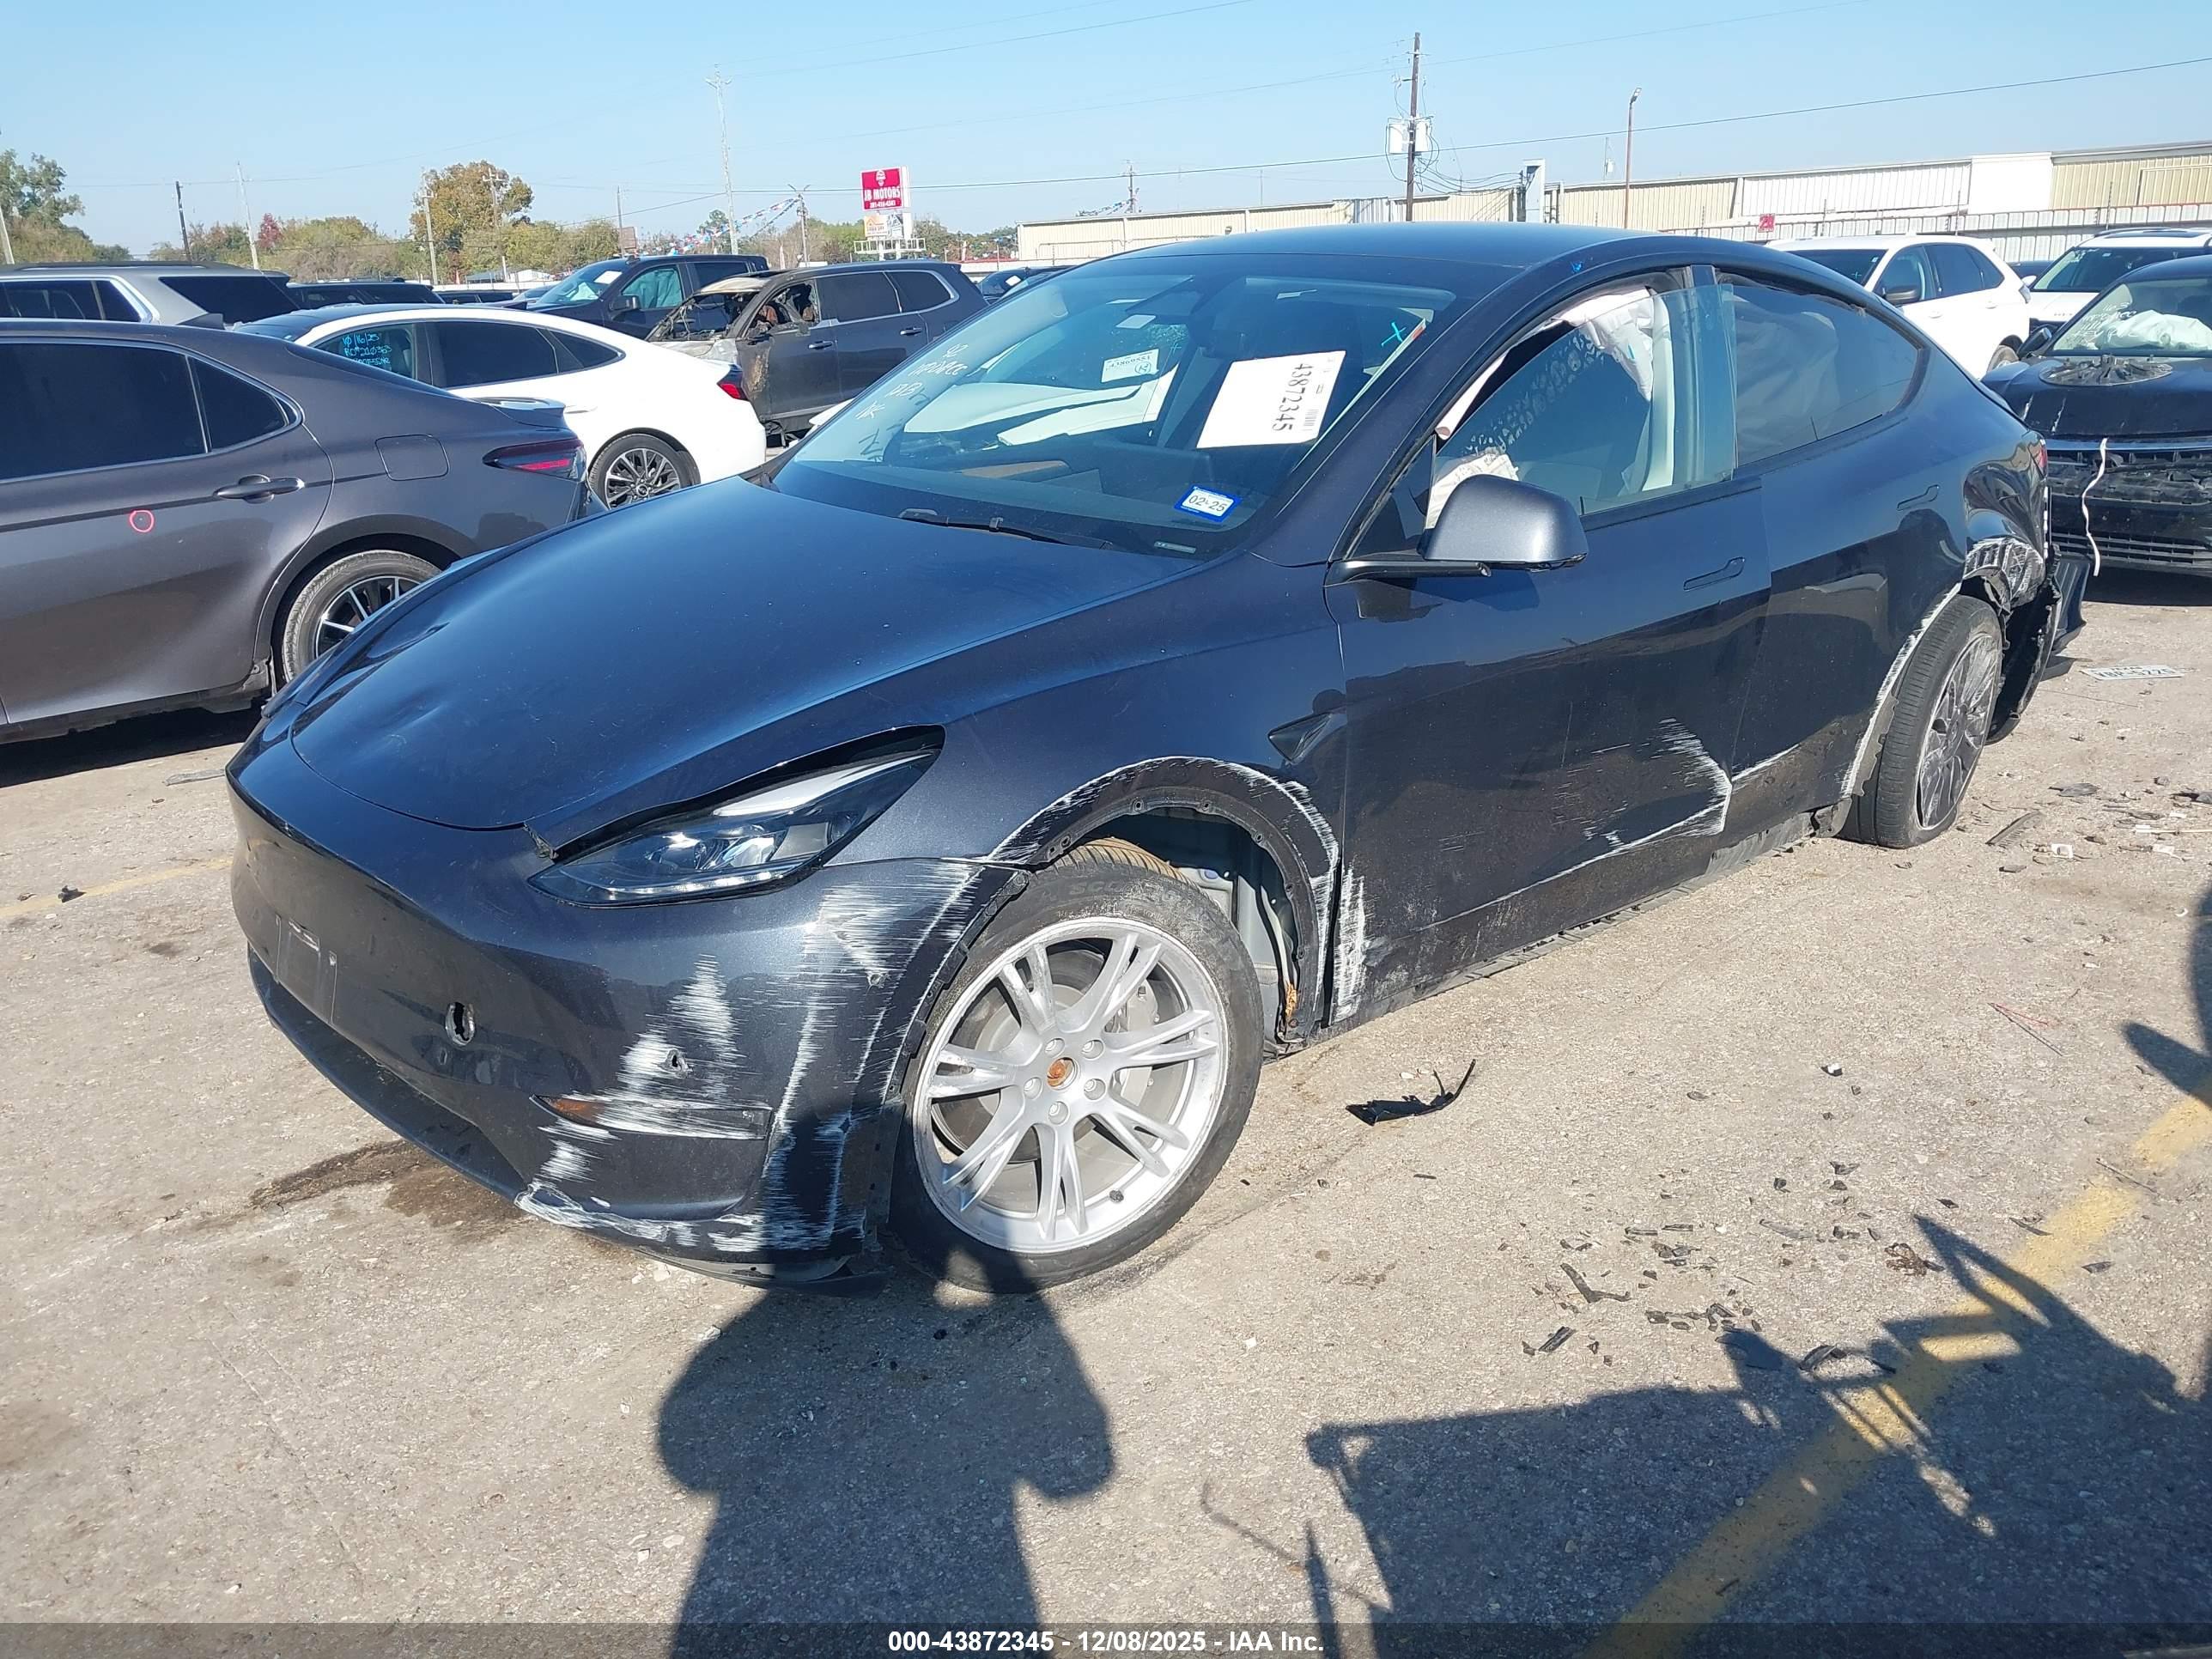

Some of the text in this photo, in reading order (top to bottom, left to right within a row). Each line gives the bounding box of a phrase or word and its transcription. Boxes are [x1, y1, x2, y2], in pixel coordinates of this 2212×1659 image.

[864, 185, 901, 201] JB MOTORS
[1272, 363, 1314, 431] 43872345
[1188, 495, 1206, 506] 02
[1208, 501, 1227, 512] 25
